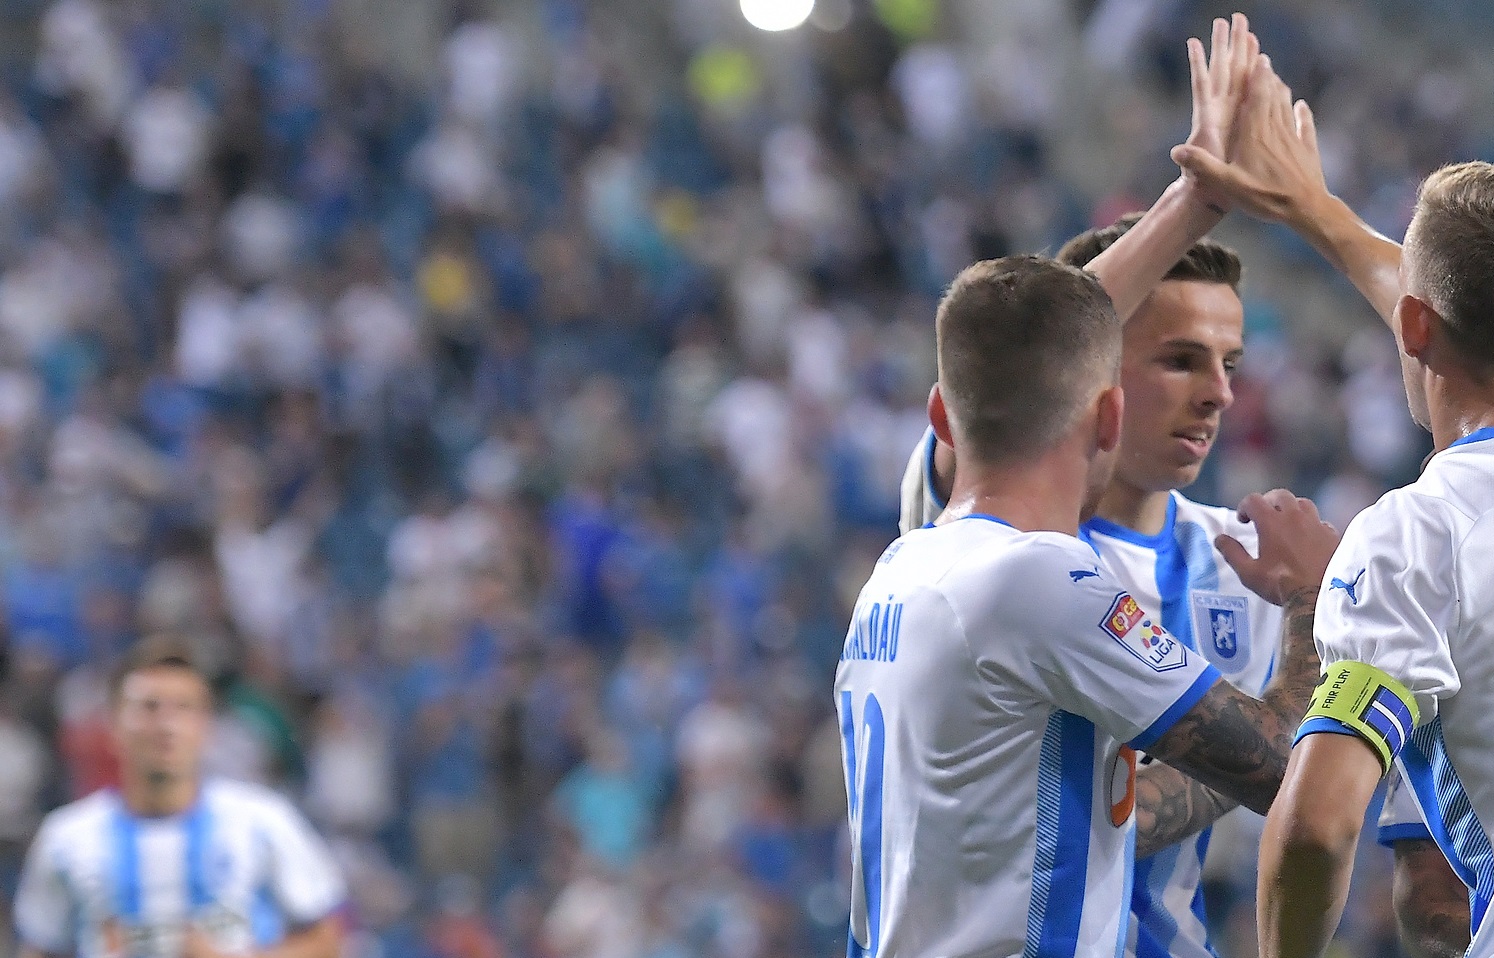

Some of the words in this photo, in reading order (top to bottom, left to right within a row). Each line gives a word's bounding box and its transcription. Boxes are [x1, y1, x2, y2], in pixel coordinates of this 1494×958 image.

[1149, 638, 1177, 664] LIGA
[1321, 689, 1340, 709] FAIR
[1332, 668, 1351, 690] PLAY
